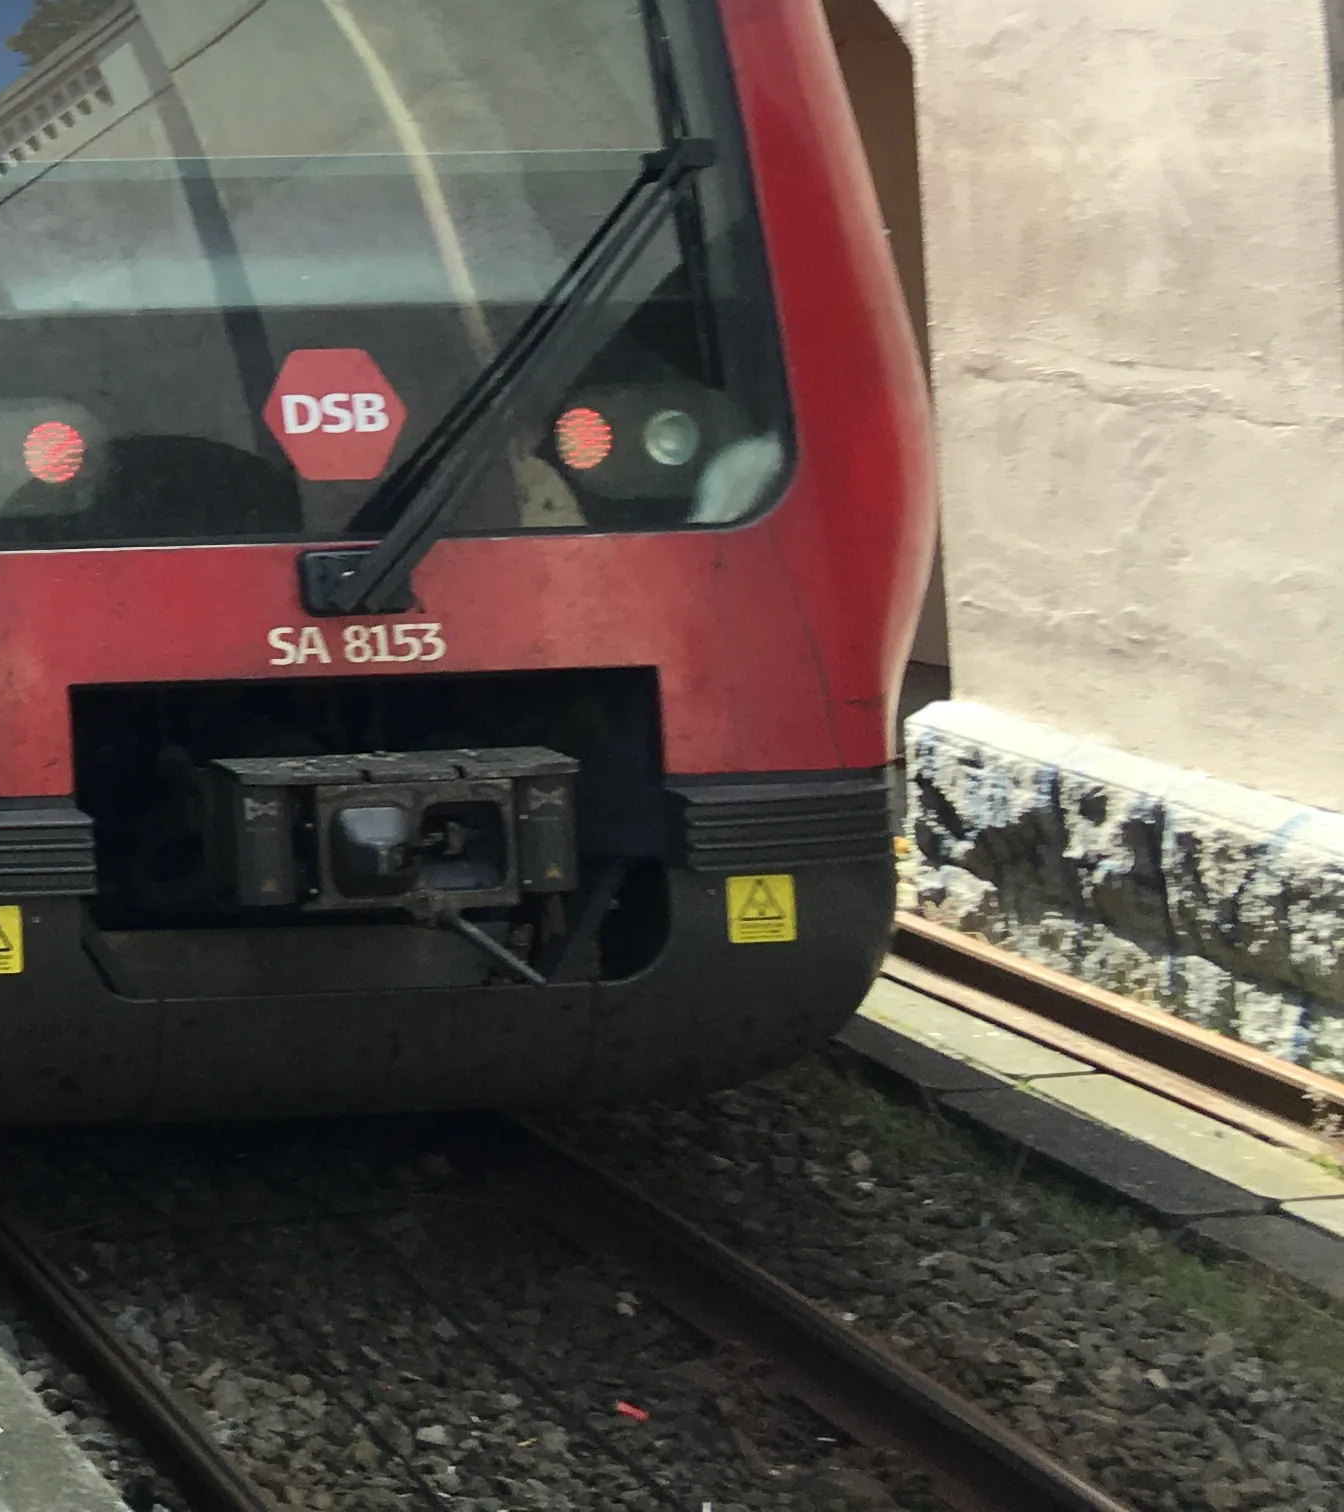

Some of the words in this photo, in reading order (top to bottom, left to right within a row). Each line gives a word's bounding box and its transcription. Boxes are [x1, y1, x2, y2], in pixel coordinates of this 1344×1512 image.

[280, 392, 390, 434] DSB
[267, 626, 332, 666] SA
[342, 622, 448, 664] 8153
